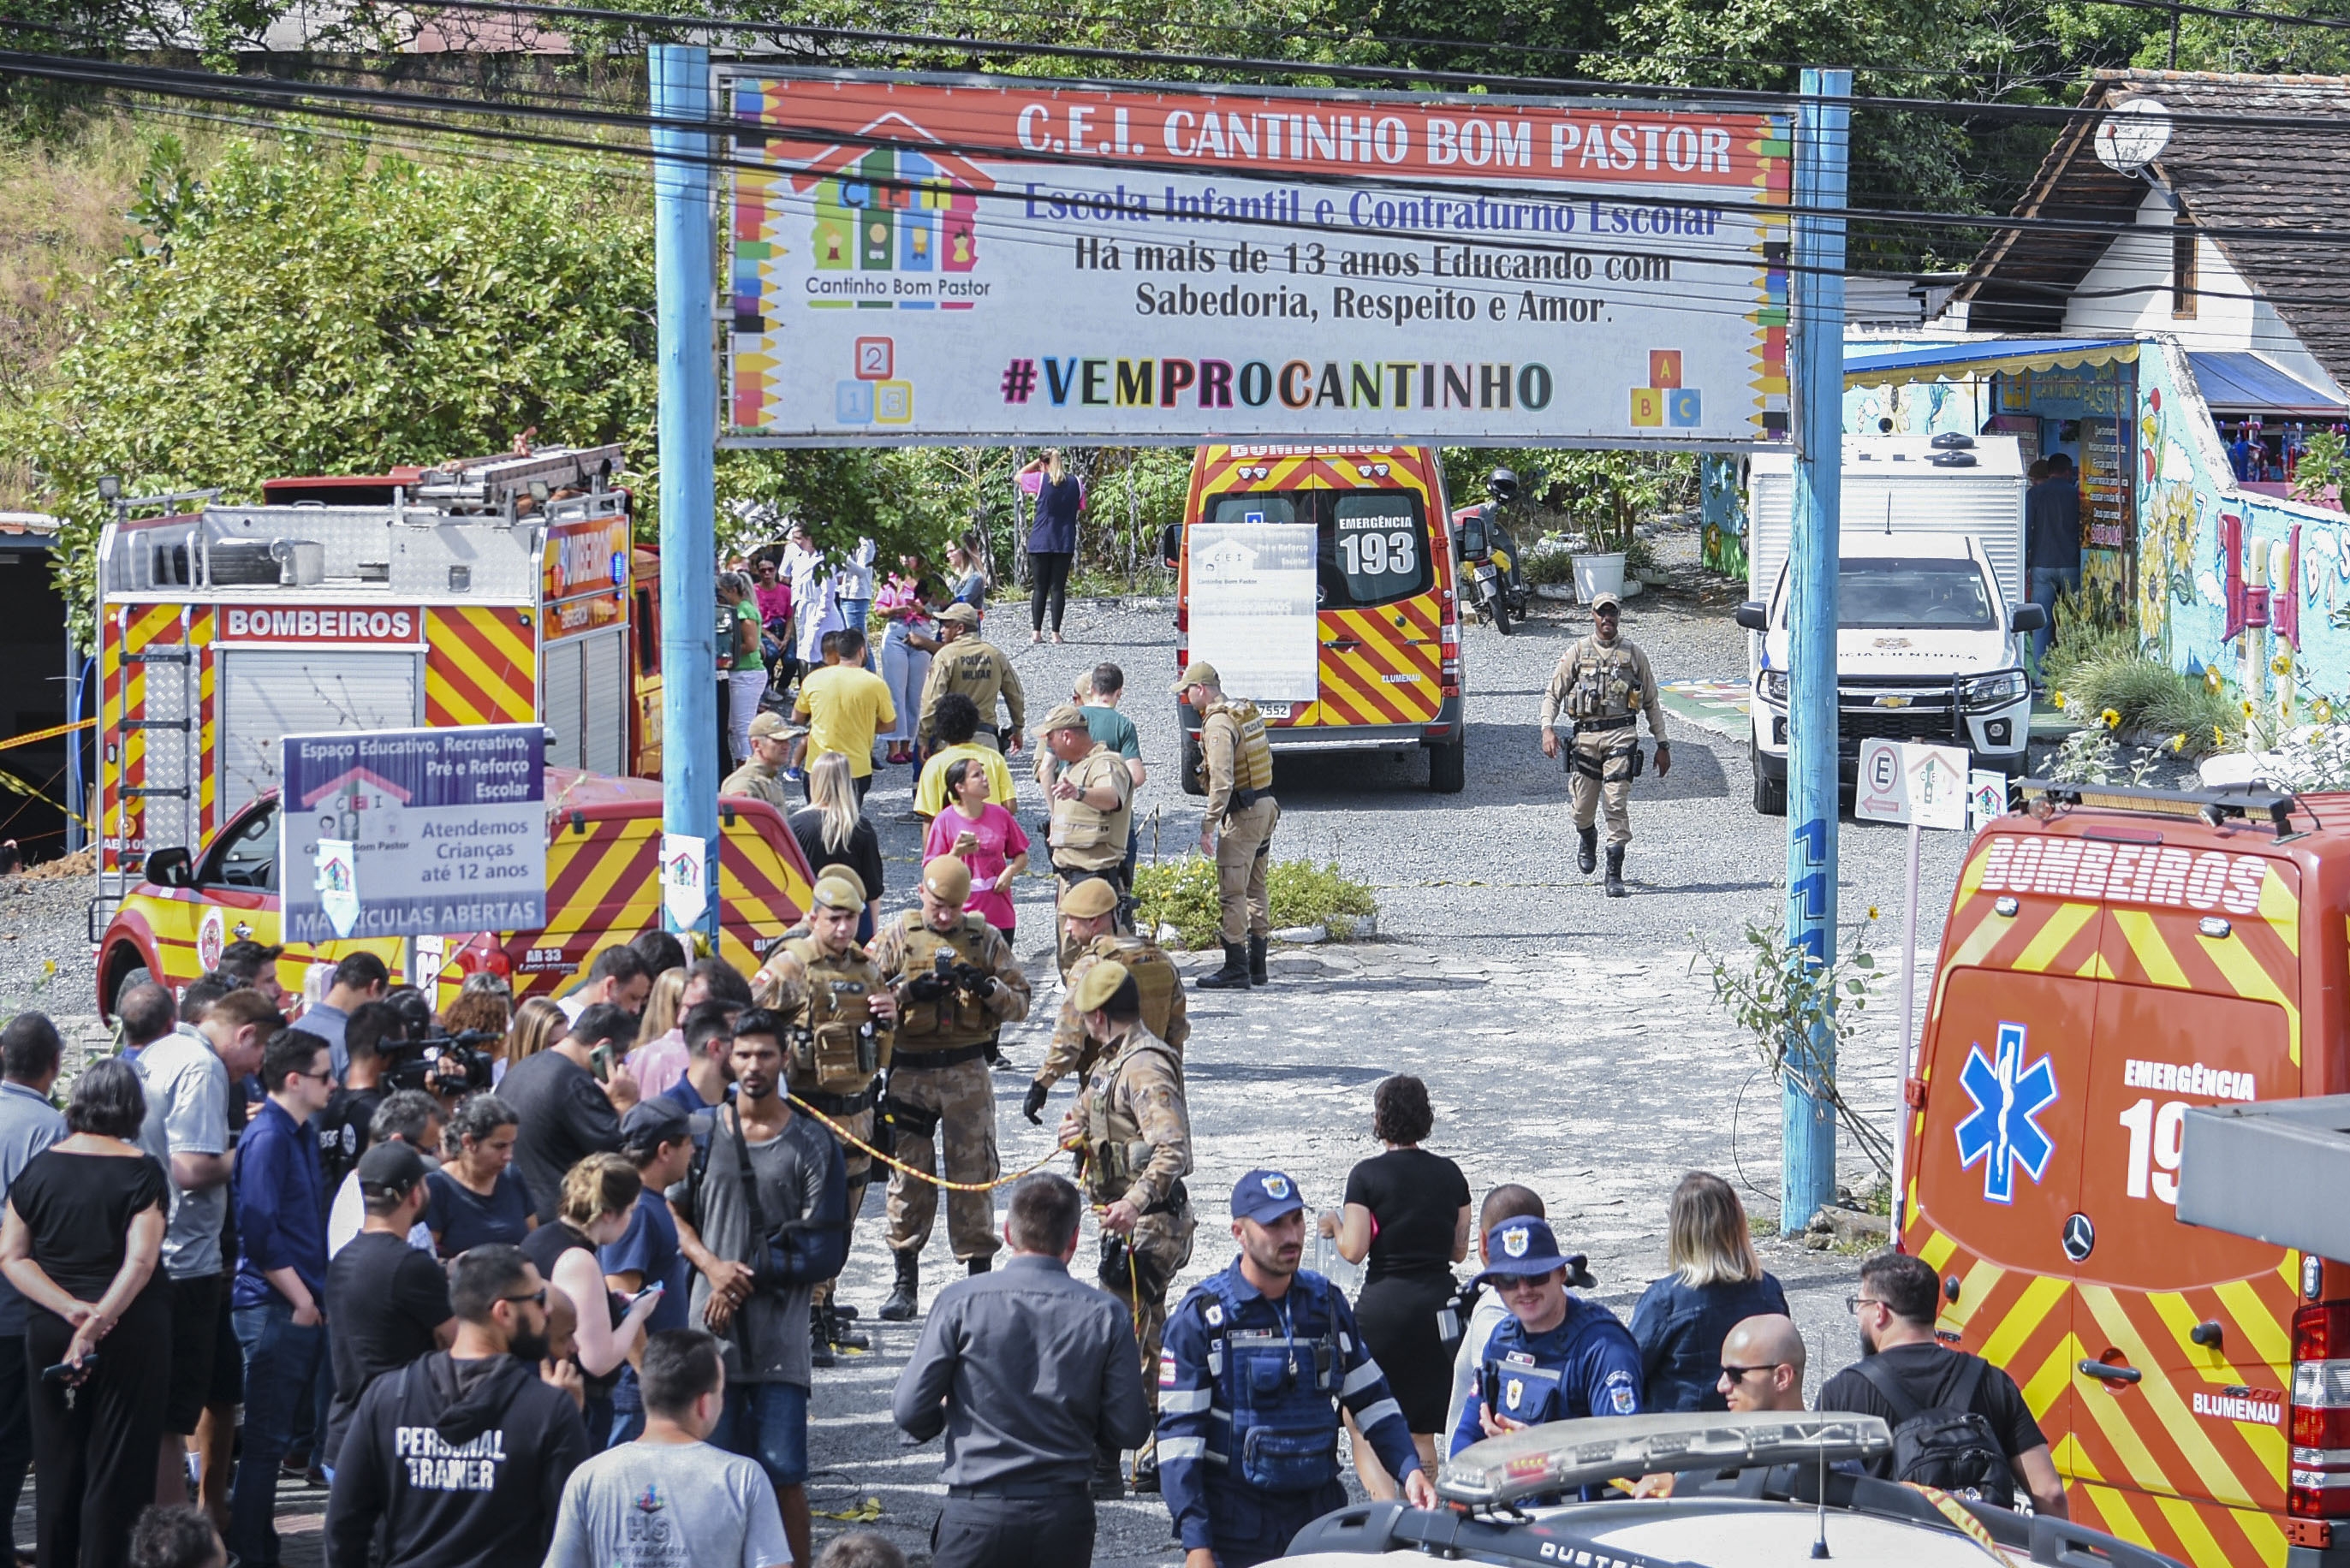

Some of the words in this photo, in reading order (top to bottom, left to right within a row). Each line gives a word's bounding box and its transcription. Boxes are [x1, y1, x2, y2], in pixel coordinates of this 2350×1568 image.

[1016, 102, 1145, 156] C.E.I.
[1163, 109, 1409, 164] CANTINHO
[1426, 118, 1532, 168] BOM
[1550, 122, 1731, 174] PASTOR
[1025, 181, 1151, 222] Escola
[1164, 186, 1300, 224] Infantil
[1314, 199, 1335, 226] e
[1348, 190, 1576, 233] Contraturno
[1589, 199, 1724, 236] Escolar
[1074, 236, 1121, 271] Há
[1133, 240, 1216, 273] mais
[1228, 241, 1268, 275] de
[1284, 242, 1326, 276] 13
[1338, 248, 1420, 277] anos
[1432, 245, 1592, 281] Educando
[1604, 255, 1671, 282] com
[805, 276, 887, 294] Cantinho
[893, 278, 932, 295] Bom
[937, 279, 991, 296] Pastor
[1135, 282, 1318, 324] Sabedoria,
[1332, 286, 1477, 327] Respeito
[1488, 295, 1507, 321] e
[1517, 289, 1613, 323] Amor.
[866, 346, 883, 371] 2
[1659, 358, 1671, 379] A
[1000, 354, 1555, 413] #VEMPROCANTINHO
[1640, 398, 1652, 417] B
[1679, 398, 1692, 419] C
[1339, 514, 1413, 531] EMERGÊNCIA
[1339, 532, 1415, 575] 193
[228, 609, 412, 638] BOMBEIROS
[1381, 673, 1421, 683] BLUMENAU
[1258, 705, 1287, 716] 7552
[300, 741, 355, 762] Espaço
[359, 738, 440, 758] Educativo,
[443, 734, 530, 752] Recreativo,
[425, 760, 453, 776] Pré
[455, 763, 465, 775] e
[469, 757, 530, 777] Reforço
[1875, 755, 1890, 785] E
[475, 781, 531, 799] Escolar
[421, 819, 529, 839] Atendemos
[378, 840, 409, 852] Pastor
[436, 840, 515, 862] Crianças
[421, 864, 452, 882] até
[459, 864, 479, 880] 12
[485, 863, 529, 879] anos
[1980, 837, 2269, 915] BOMBEIROS
[295, 906, 436, 933] MAÍCULAS
[440, 900, 537, 926] ABERTAS
[544, 947, 562, 962] 33
[2124, 1058, 2256, 1101] EMERGÊNCIA
[2119, 1098, 2192, 1205] 19
[2192, 1392, 2281, 1424] BLUMENAU
[395, 1426, 508, 1462] PERSNAL
